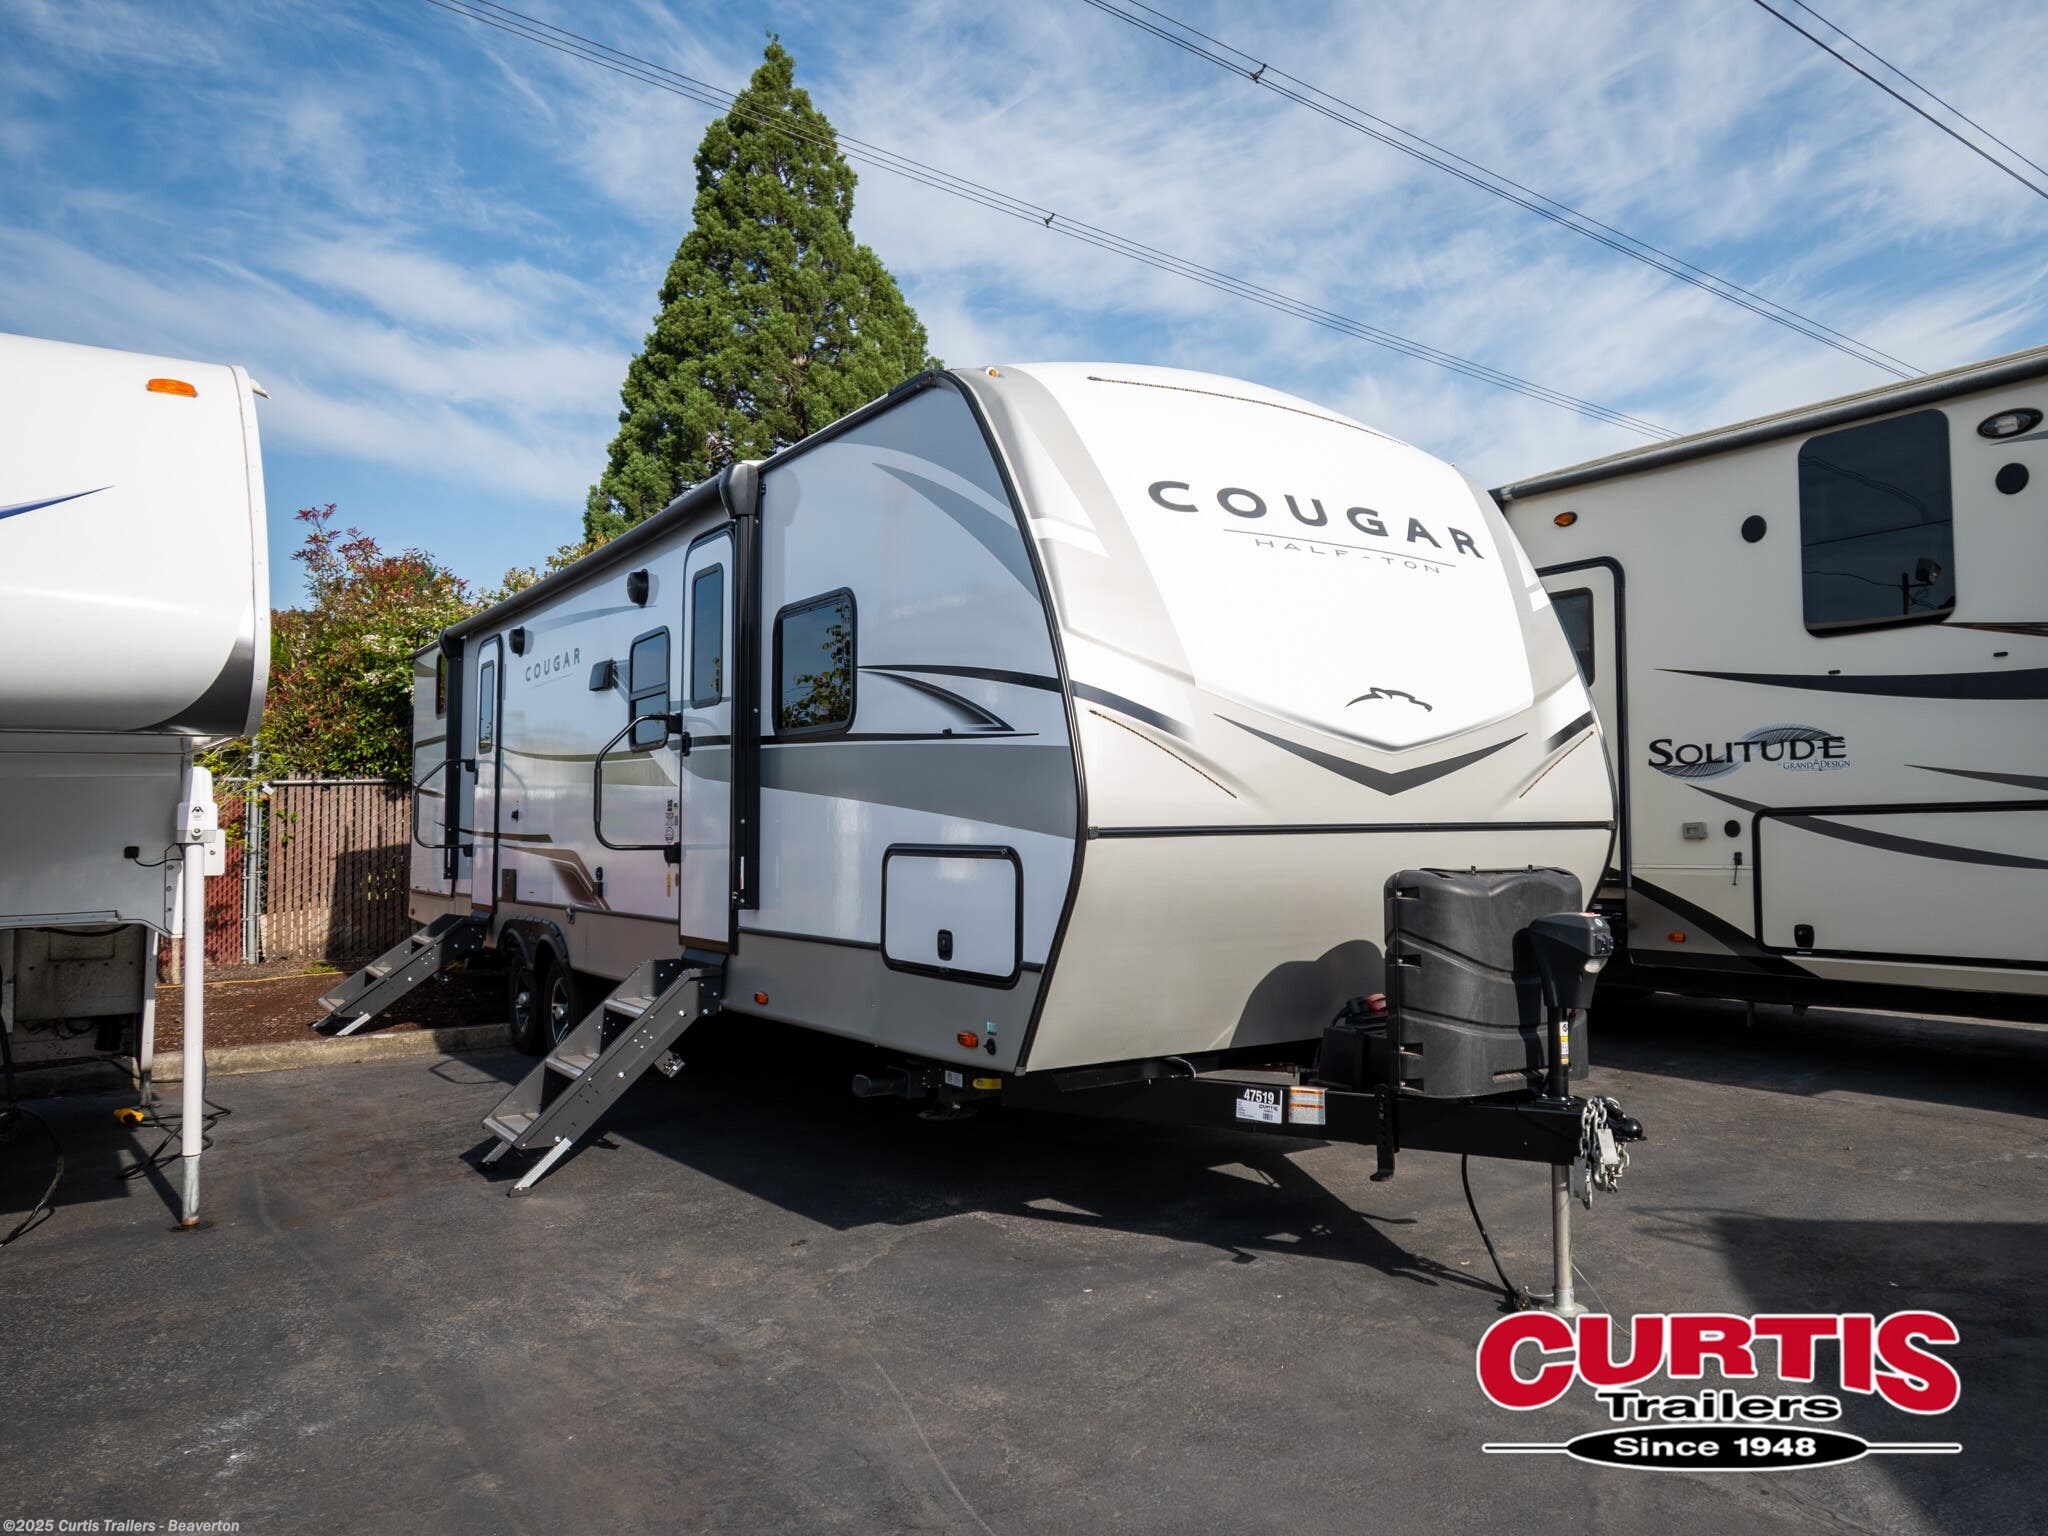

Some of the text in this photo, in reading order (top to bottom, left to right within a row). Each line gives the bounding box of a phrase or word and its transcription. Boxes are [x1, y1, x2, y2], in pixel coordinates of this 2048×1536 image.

[1148, 480, 1484, 559] COUGAR
[1255, 538, 1440, 574] HALF-TON
[525, 647, 581, 682] COUGAR
[1648, 736, 1847, 766] SOLITUDE
[1244, 1088, 1275, 1105] 47519
